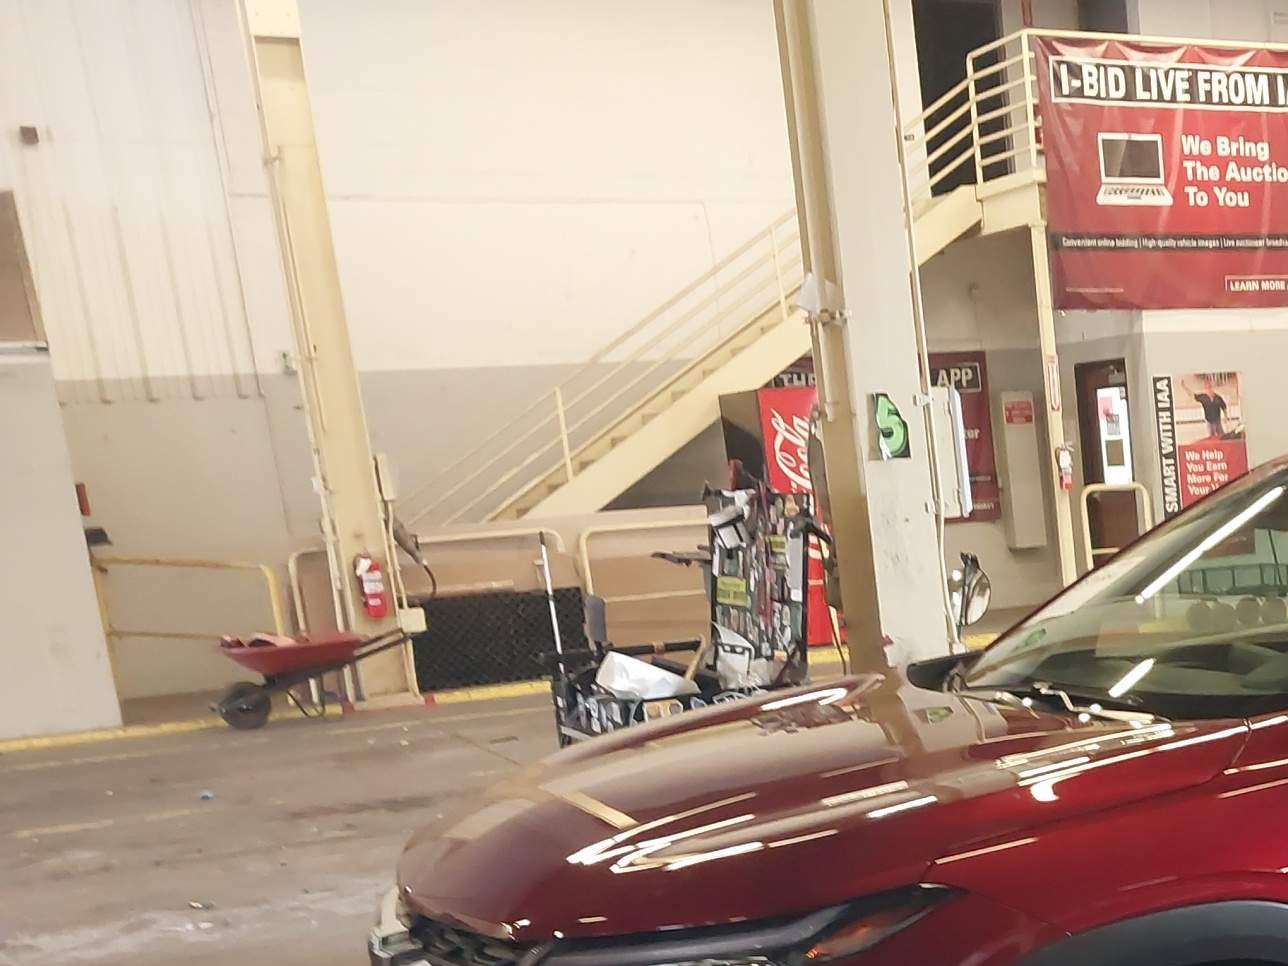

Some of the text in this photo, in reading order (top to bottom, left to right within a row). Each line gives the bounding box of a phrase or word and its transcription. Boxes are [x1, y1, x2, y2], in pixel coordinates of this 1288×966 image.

[1060, 63, 1126, 99] I-BID
[1135, 67, 1191, 102] LIVE
[1197, 70, 1270, 105] FROM
[1181, 134, 1270, 162] We Bring
[1183, 160, 1220, 181] The
[1184, 186, 1250, 207] To You
[1230, 280, 1260, 292] LEARN
[1261, 280, 1285, 291] MORE
[937, 367, 973, 388] APP
[1156, 379, 1179, 513] SMART WITH IAA
[1185, 449, 1224, 462] We Help
[1186, 461, 1228, 473] You Earn
[1187, 472, 1229, 484] More For
[1187, 484, 1210, 496] Your
